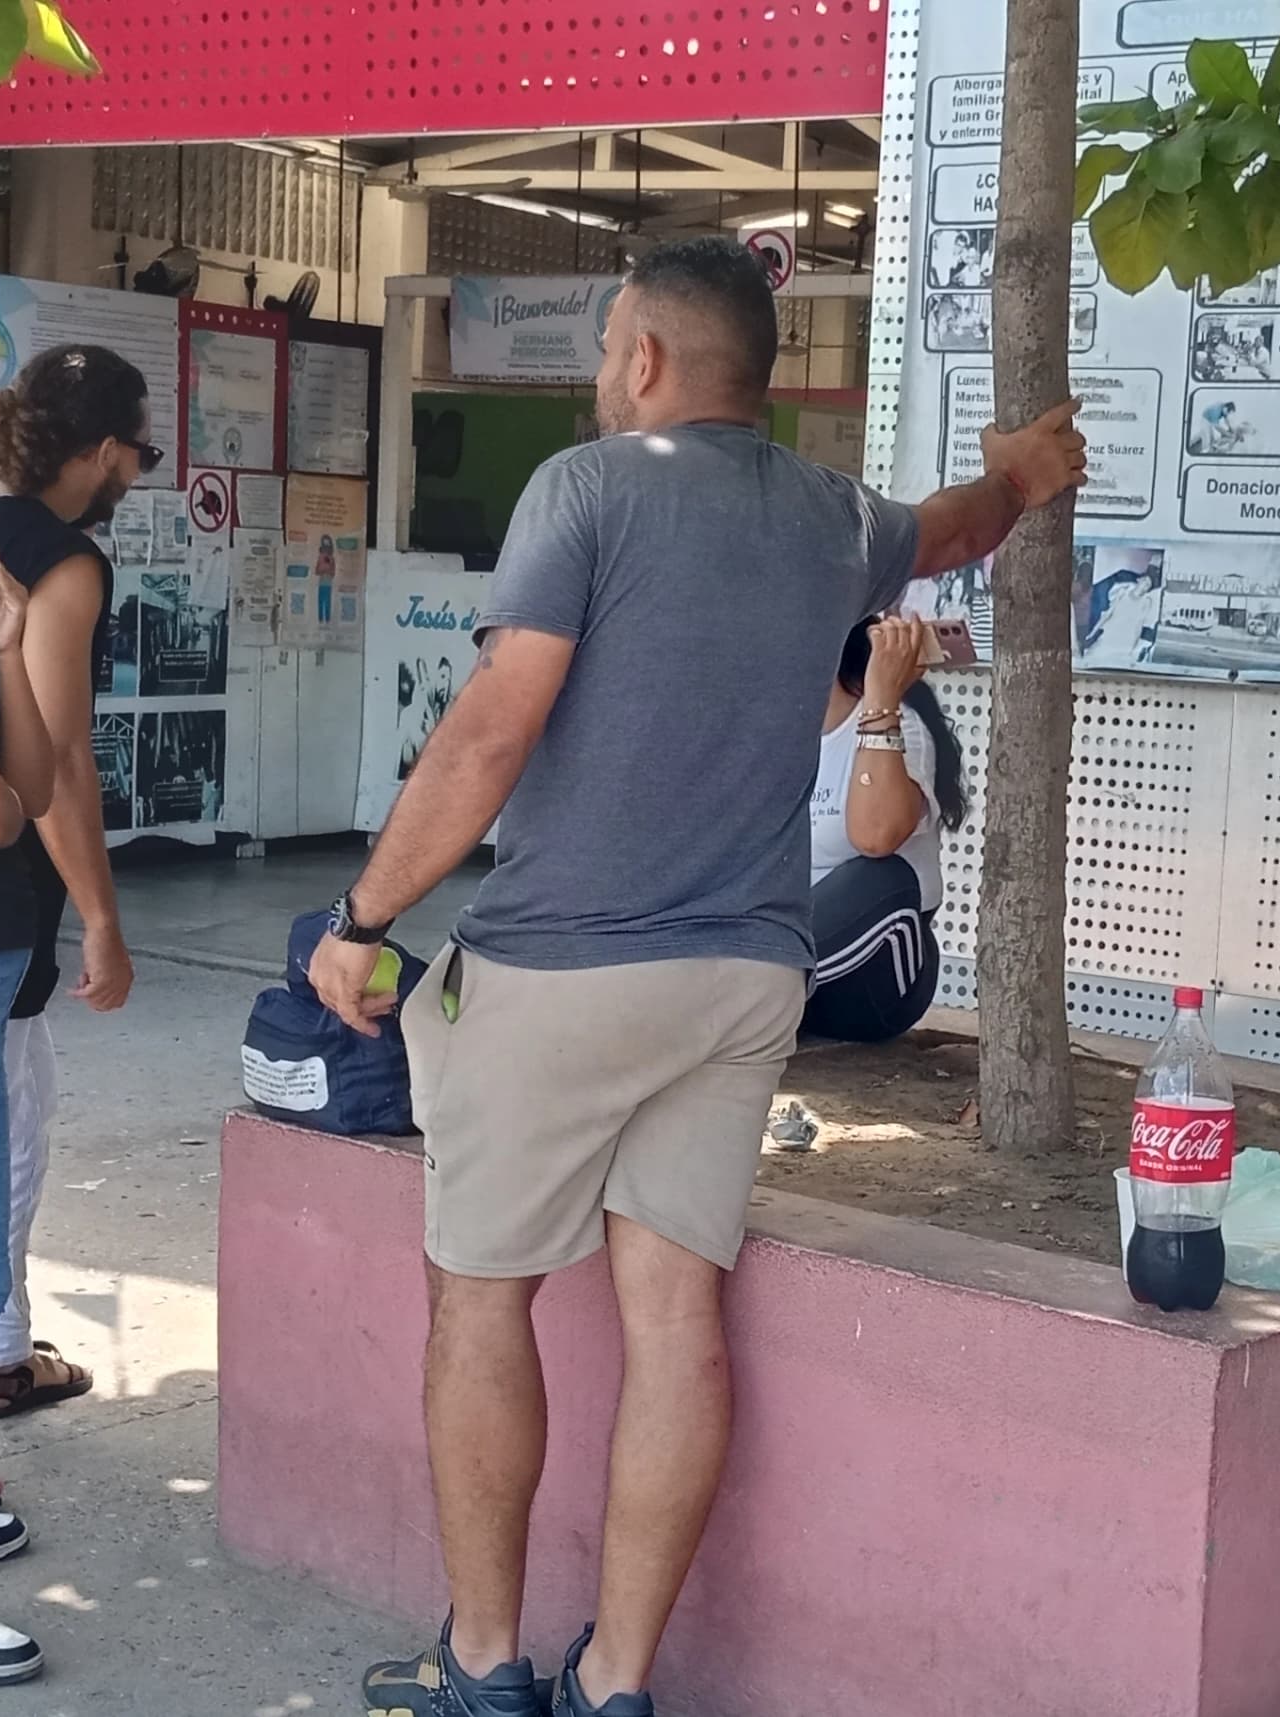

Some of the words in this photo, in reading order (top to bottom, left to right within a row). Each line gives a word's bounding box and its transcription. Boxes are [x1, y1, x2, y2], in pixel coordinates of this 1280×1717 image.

[1094, 73, 1103, 84] y
[952, 109, 980, 124] Juan
[939, 129, 948, 142] y
[976, 173, 997, 189] ¿C
[512, 335, 574, 346] HERMANO
[395, 595, 457, 631] Jesús
[1131, 1112, 1231, 1161] Coca-Cola
